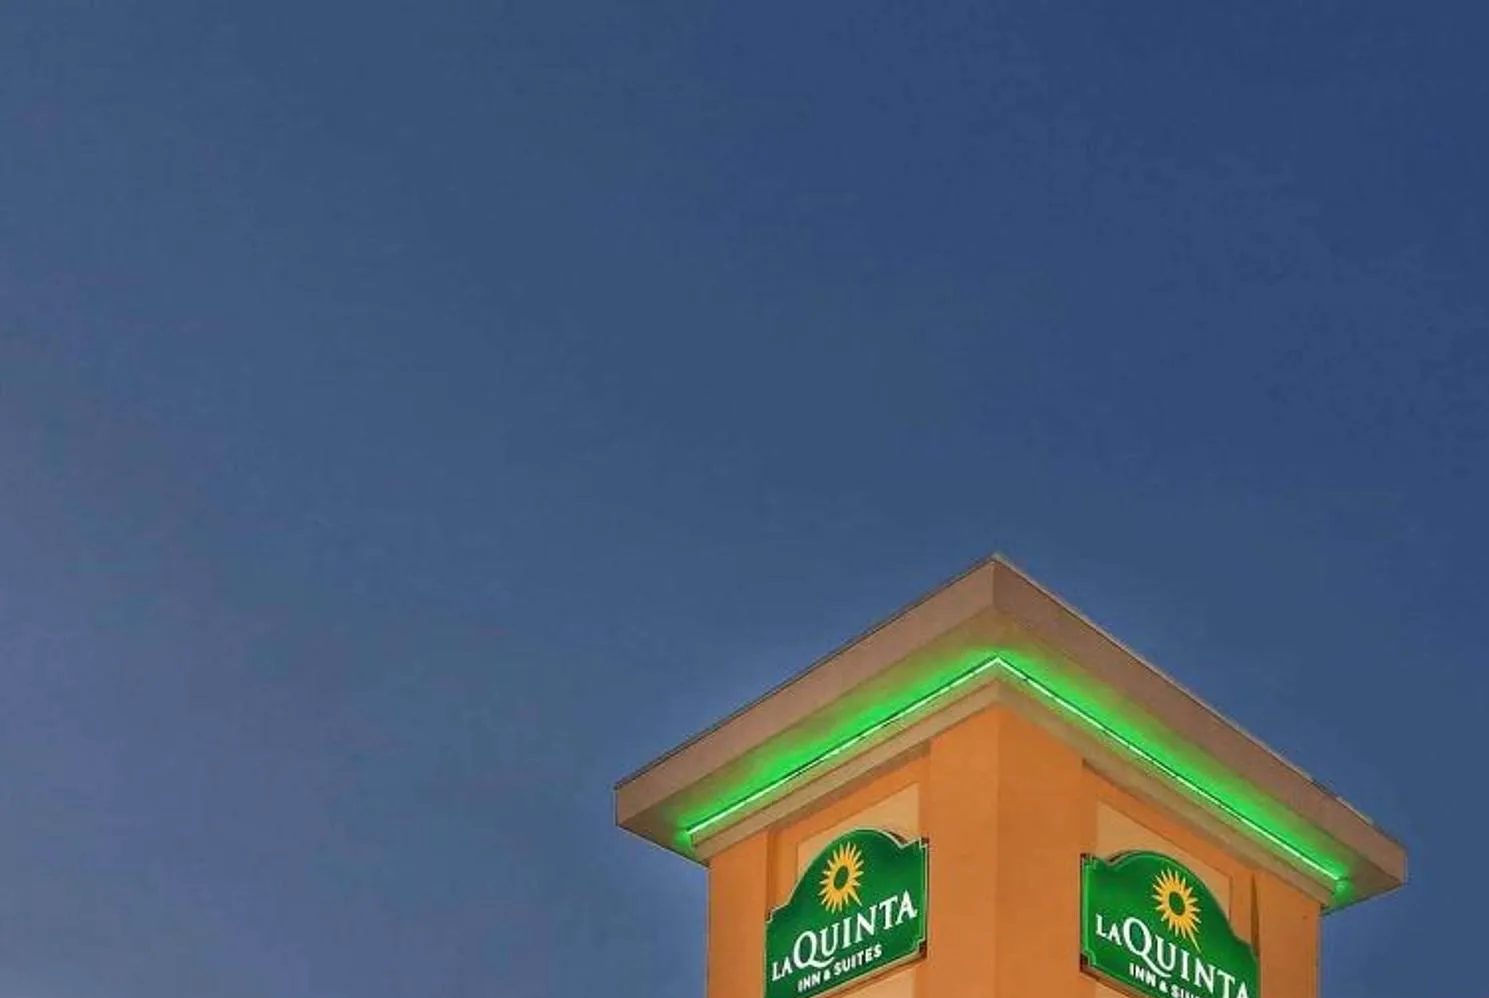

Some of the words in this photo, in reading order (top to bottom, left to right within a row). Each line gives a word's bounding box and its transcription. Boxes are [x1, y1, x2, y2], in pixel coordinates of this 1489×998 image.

[772, 956, 793, 981] LA
[793, 890, 918, 969] QUINTA
[1095, 913, 1122, 946] LA
[797, 971, 821, 993] INN
[833, 944, 882, 976] SUITES
[1129, 962, 1156, 988] INN
[1158, 979, 1168, 993] &
